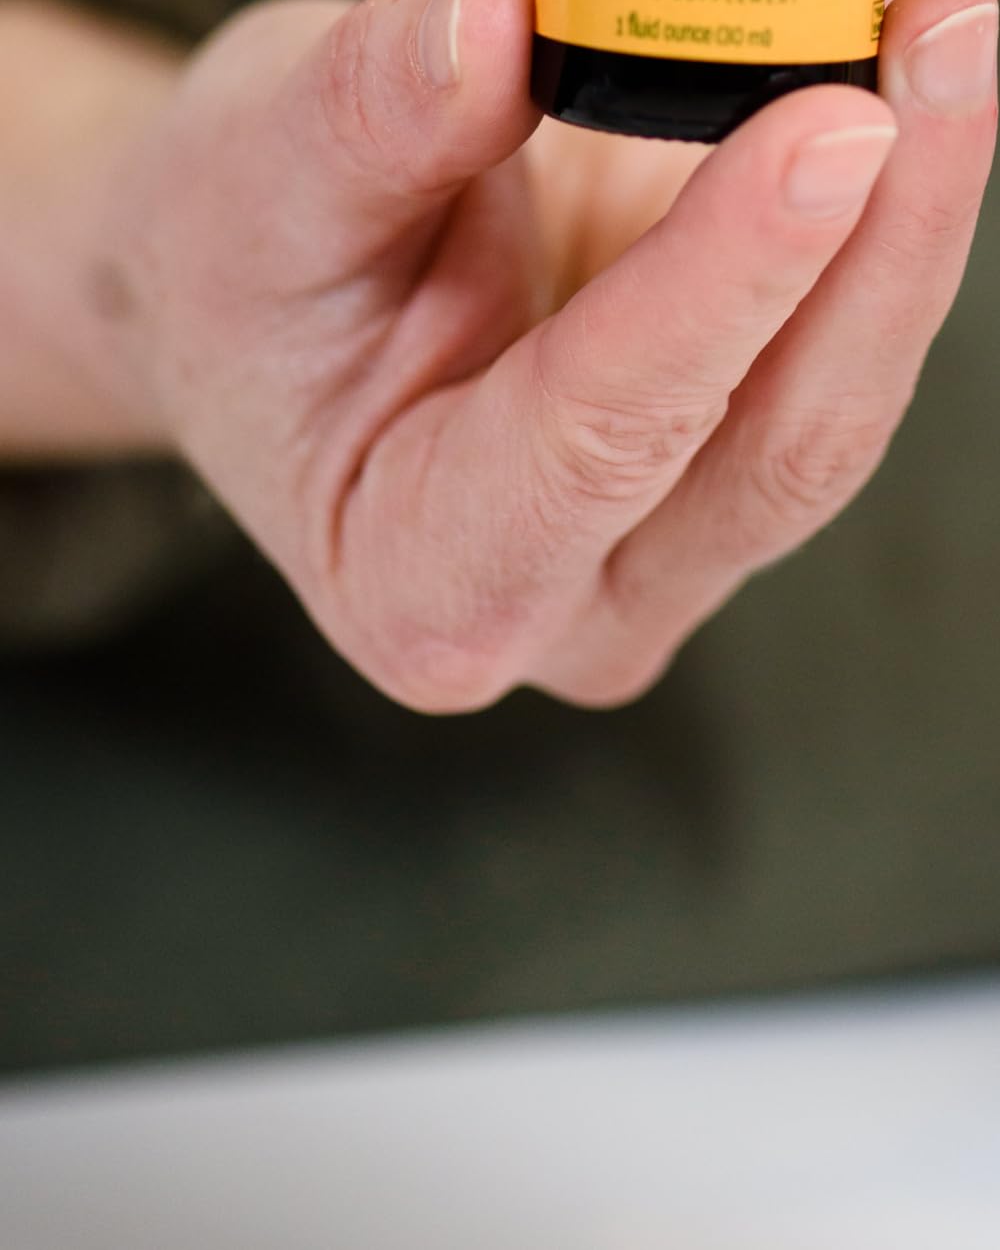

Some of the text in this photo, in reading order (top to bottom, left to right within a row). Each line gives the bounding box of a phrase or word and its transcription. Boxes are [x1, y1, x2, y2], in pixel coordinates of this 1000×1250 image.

[616, 16, 623, 37] 1
[628, 11, 660, 40] fluid
[664, 23, 712, 44] ounce
